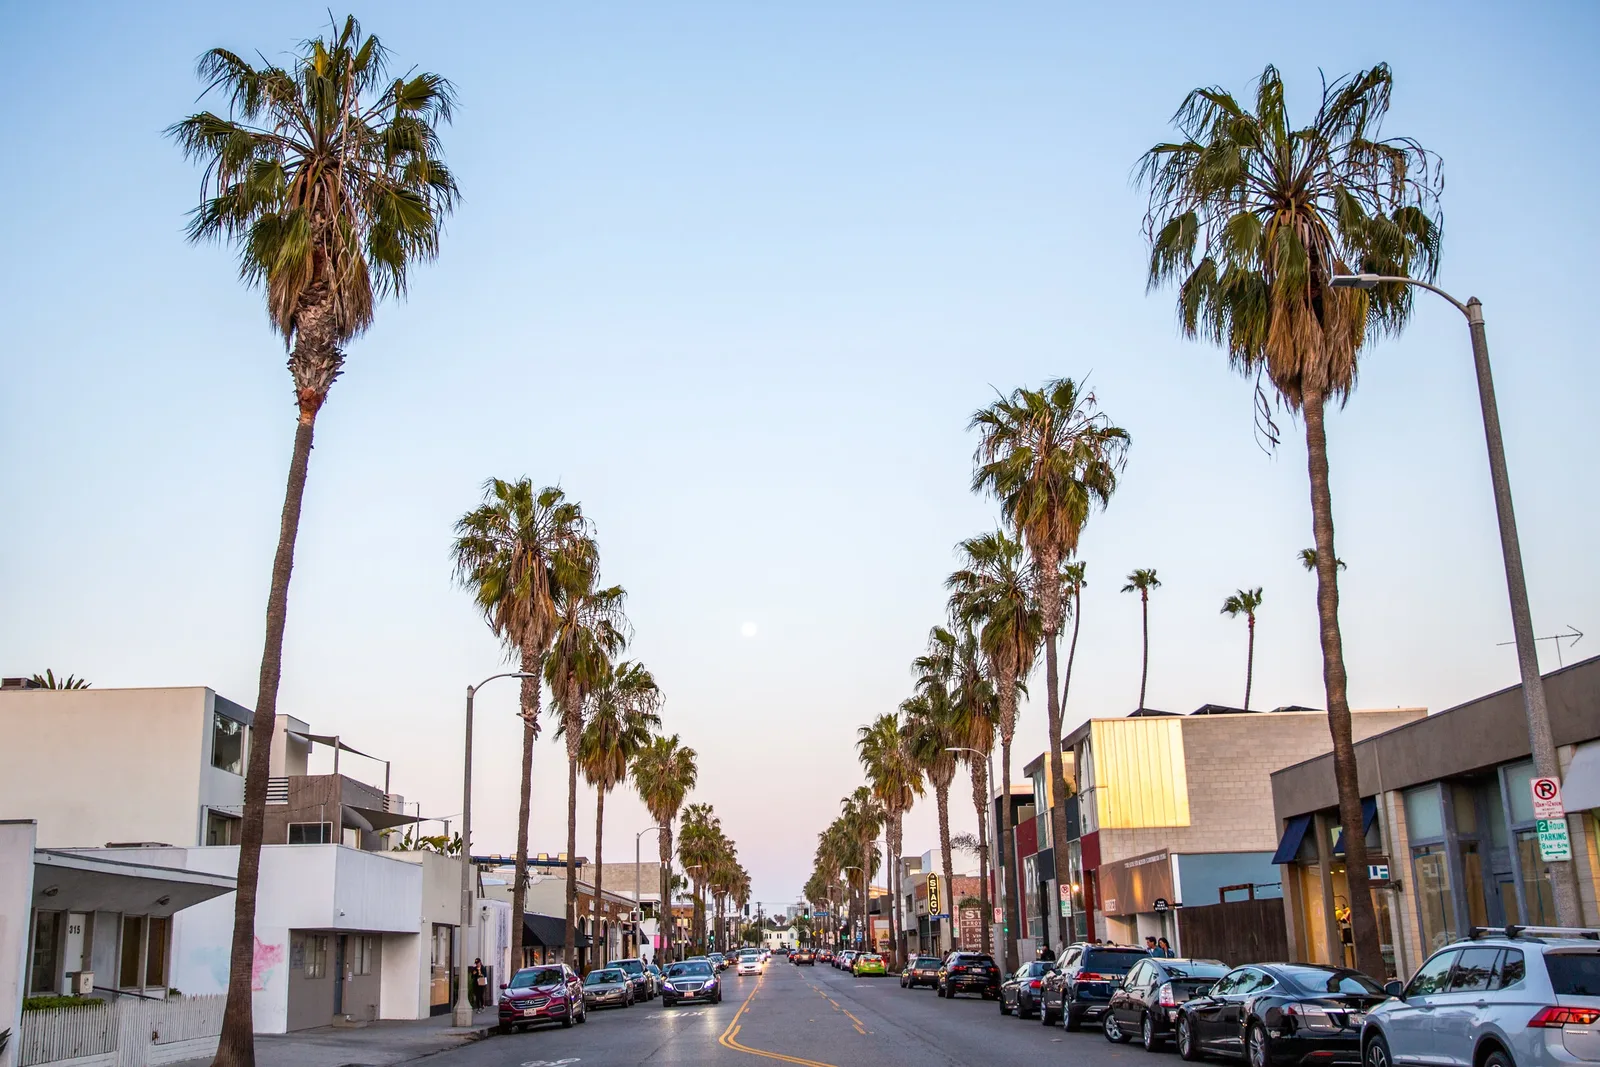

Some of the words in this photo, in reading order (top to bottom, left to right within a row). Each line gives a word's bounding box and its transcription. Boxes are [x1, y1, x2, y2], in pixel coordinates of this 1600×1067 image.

[1539, 822, 1546, 831] 2
[1548, 822, 1565, 830] HOUR
[1540, 832, 1567, 841] PARKING
[69, 925, 80, 934] 315
